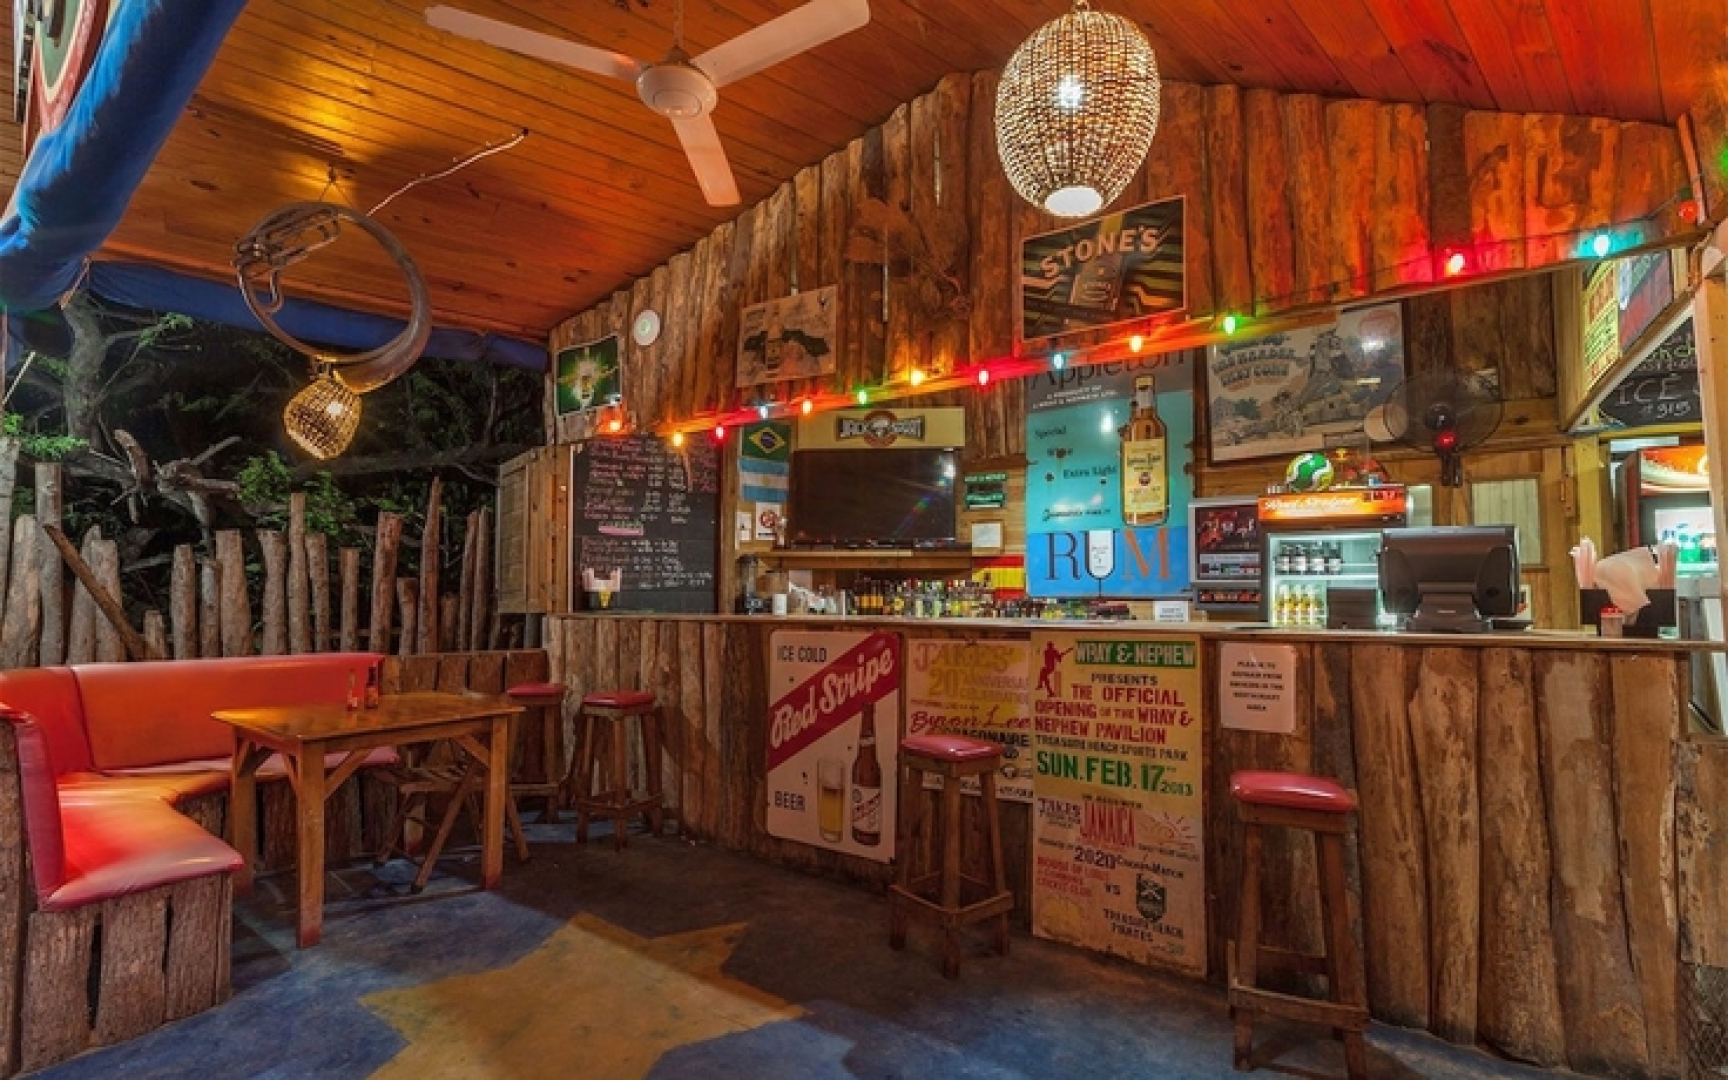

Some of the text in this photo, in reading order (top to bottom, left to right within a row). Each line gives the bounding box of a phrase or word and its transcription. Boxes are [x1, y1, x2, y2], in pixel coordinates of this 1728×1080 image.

[1040, 226, 1159, 278] STONE'S
[1046, 529, 1172, 582] RUM
[777, 645, 827, 662] ICE COLD
[1077, 642, 1194, 665] WRAY & NEPHEW
[1091, 673, 1158, 686] PRESENTS
[768, 648, 894, 749] Red Stripe
[1071, 683, 1186, 707] THE OFFICIAL
[910, 711, 978, 734] Byron
[983, 703, 1031, 728] Lee
[1034, 715, 1090, 737] NEPHEW
[1035, 700, 1097, 719] OPENING
[1138, 707, 1176, 726] WRAY
[1179, 710, 1194, 728] &
[1035, 734, 1188, 761] TREASURE BEACH SPORTS PARK
[774, 790, 806, 812] BEER
[1074, 845, 1116, 870] 2020
